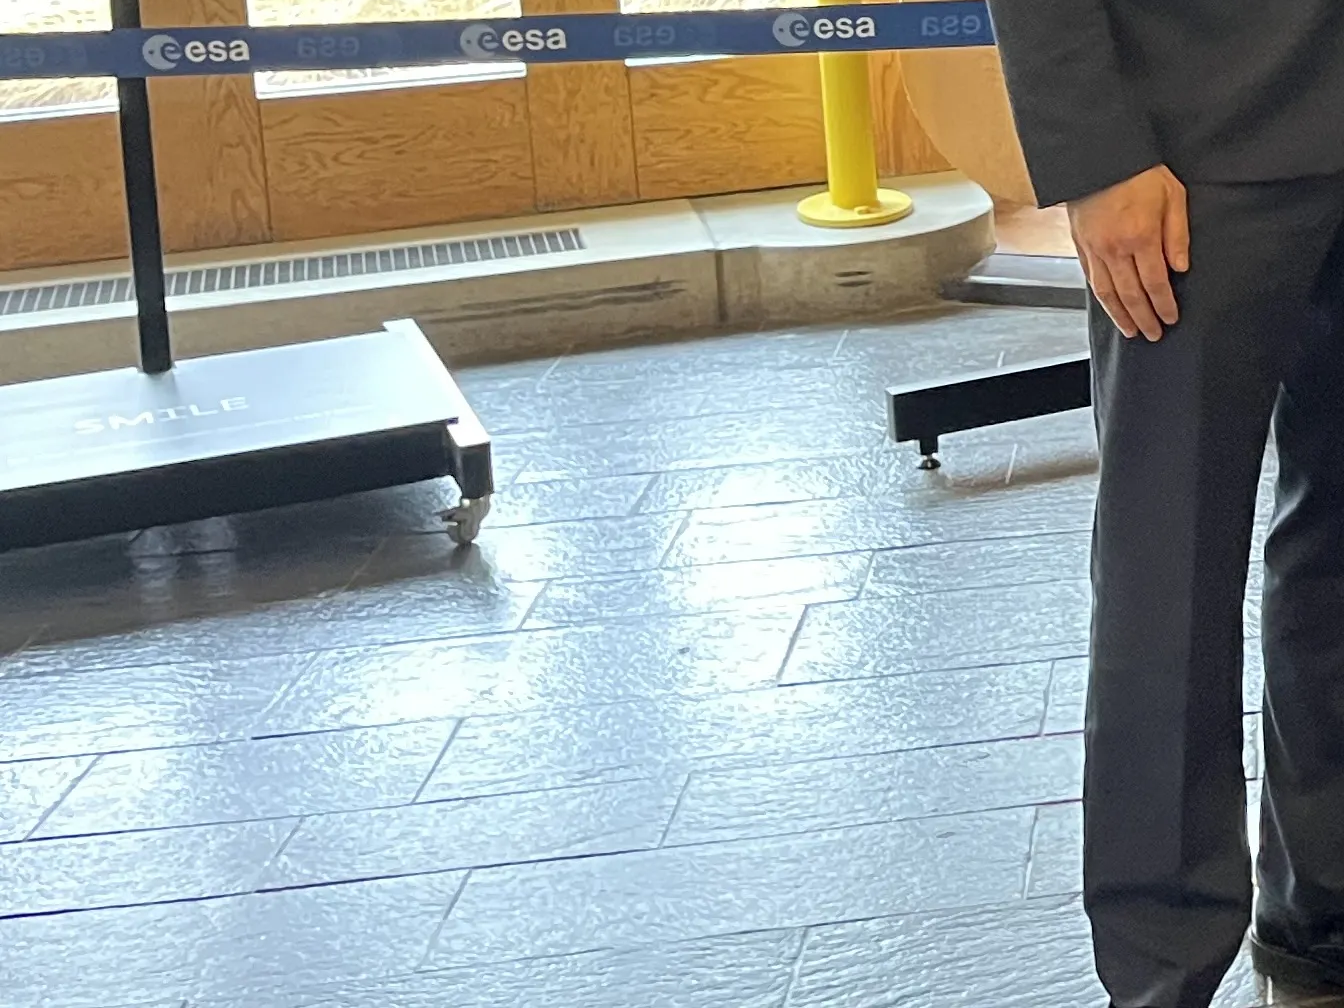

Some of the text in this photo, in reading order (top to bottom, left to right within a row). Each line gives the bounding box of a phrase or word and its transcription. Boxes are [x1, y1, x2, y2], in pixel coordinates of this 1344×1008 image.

[502, 27, 567, 52] esa
[813, 16, 876, 40] esa
[184, 39, 250, 62] esa
[74, 396, 251, 435] SMILE
